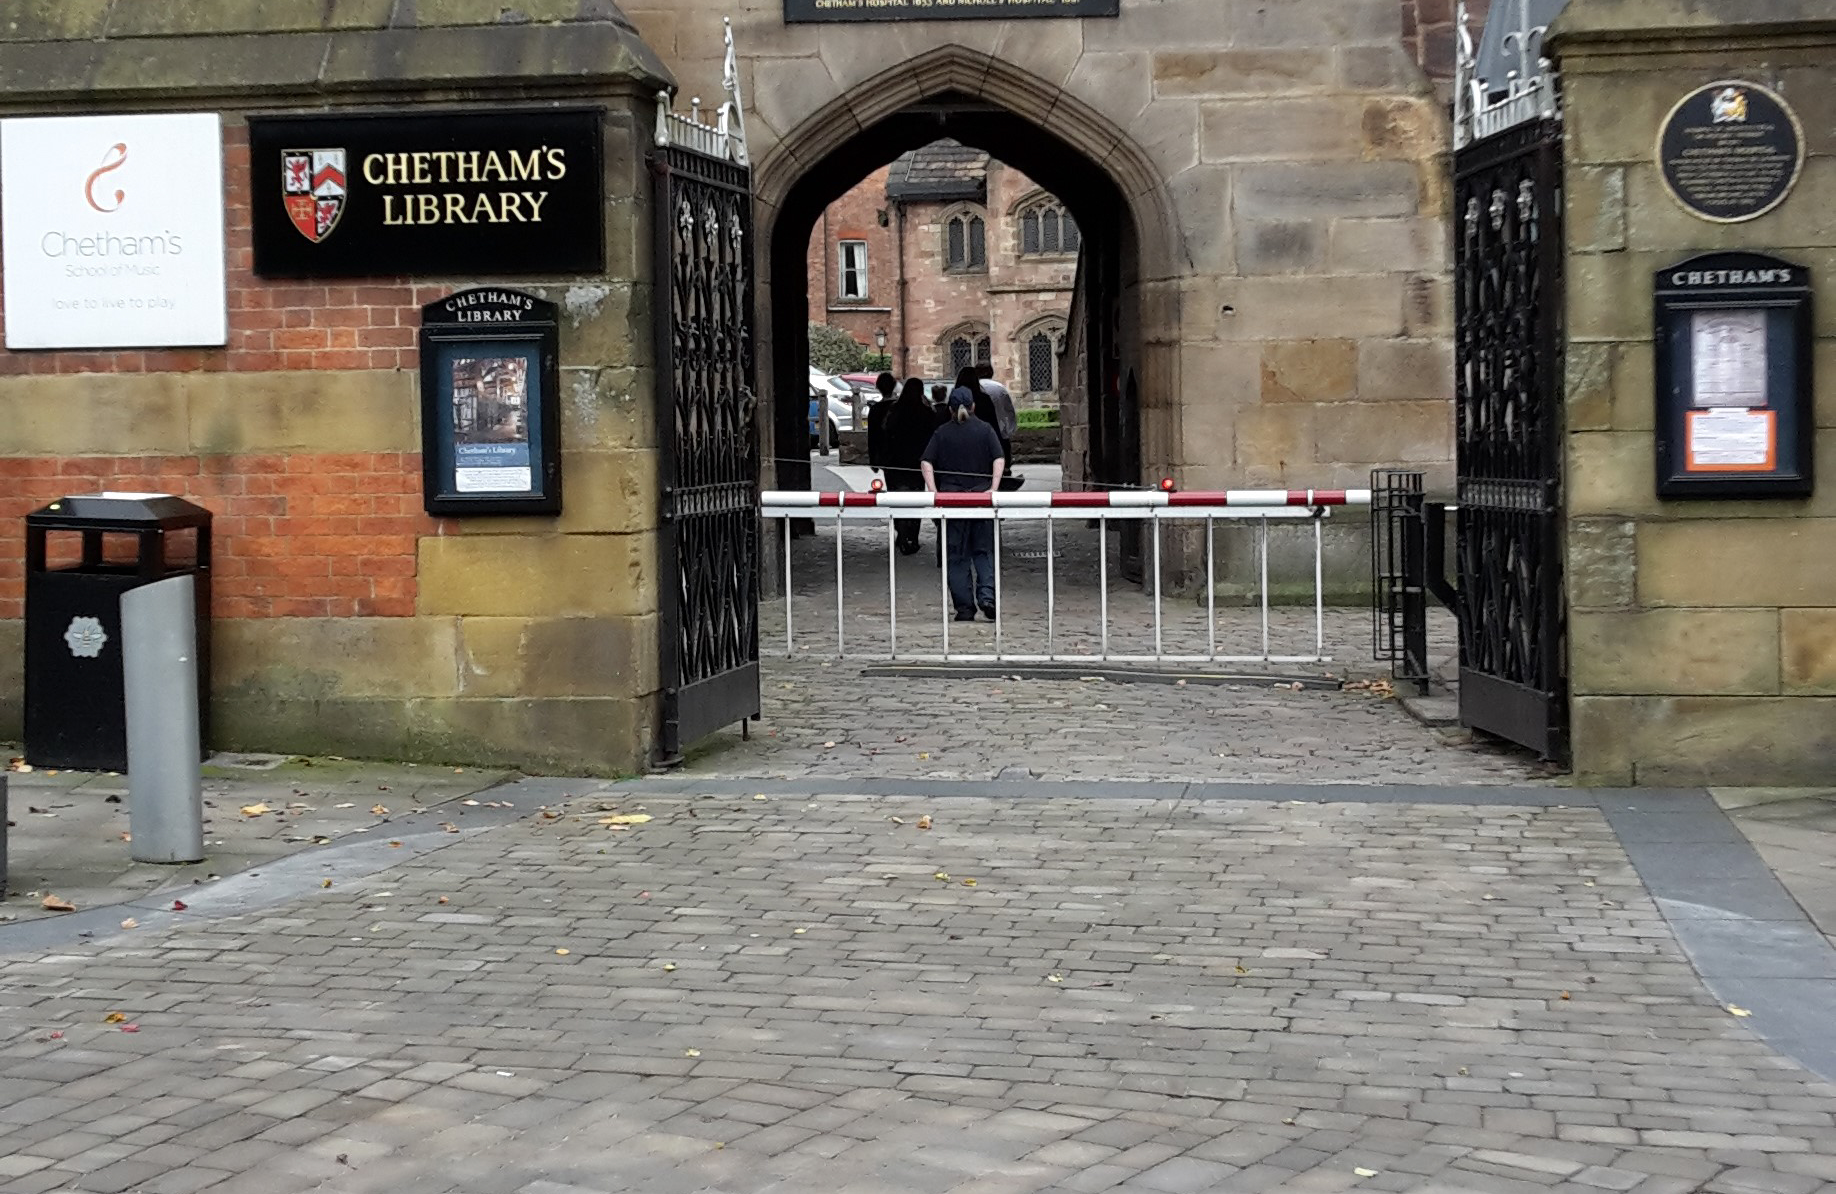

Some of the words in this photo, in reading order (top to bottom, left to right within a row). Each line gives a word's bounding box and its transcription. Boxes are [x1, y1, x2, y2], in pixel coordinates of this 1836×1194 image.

[363, 145, 567, 185] CHETHAM'S
[382, 191, 549, 225] LIBRARY
[41, 229, 183, 258] Chetham's
[1671, 268, 1792, 286] CHETHAM'S
[445, 291, 534, 312] CHETHAM'S
[457, 309, 523, 323] LIBRARY
